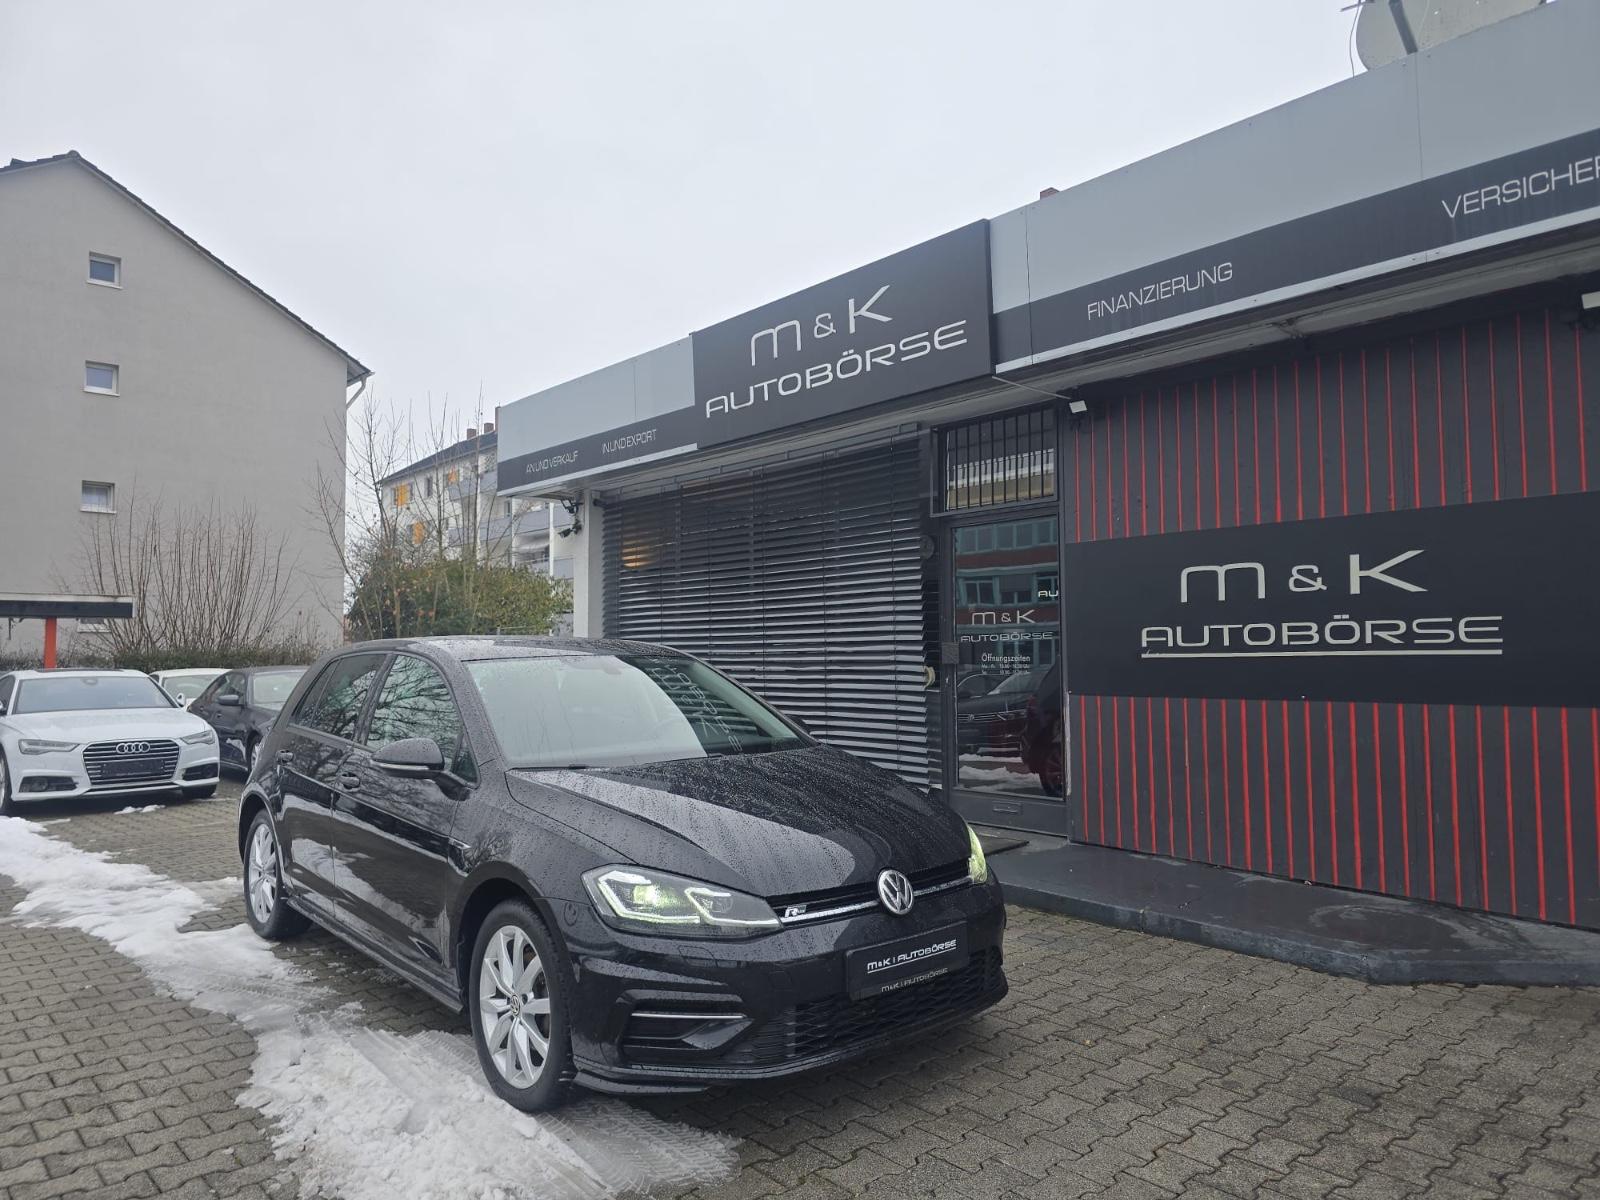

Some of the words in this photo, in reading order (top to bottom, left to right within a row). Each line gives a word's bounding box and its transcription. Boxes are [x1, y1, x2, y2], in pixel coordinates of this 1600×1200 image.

[814, 312, 836, 338] &
[849, 285, 893, 334] K
[1087, 262, 1233, 321] FINANZIERUNG
[706, 320, 967, 418] AUTOBÖRSE
[1288, 565, 1327, 592] &
[1349, 549, 1428, 595] K
[960, 631, 1054, 642] AUTOBÖRSE
[1001, 612, 1012, 623] &
[1016, 609, 1036, 624] K
[1141, 614, 1503, 648] AUTOBÖRSE
[897, 939, 957, 962] AUTOBÖRSE
